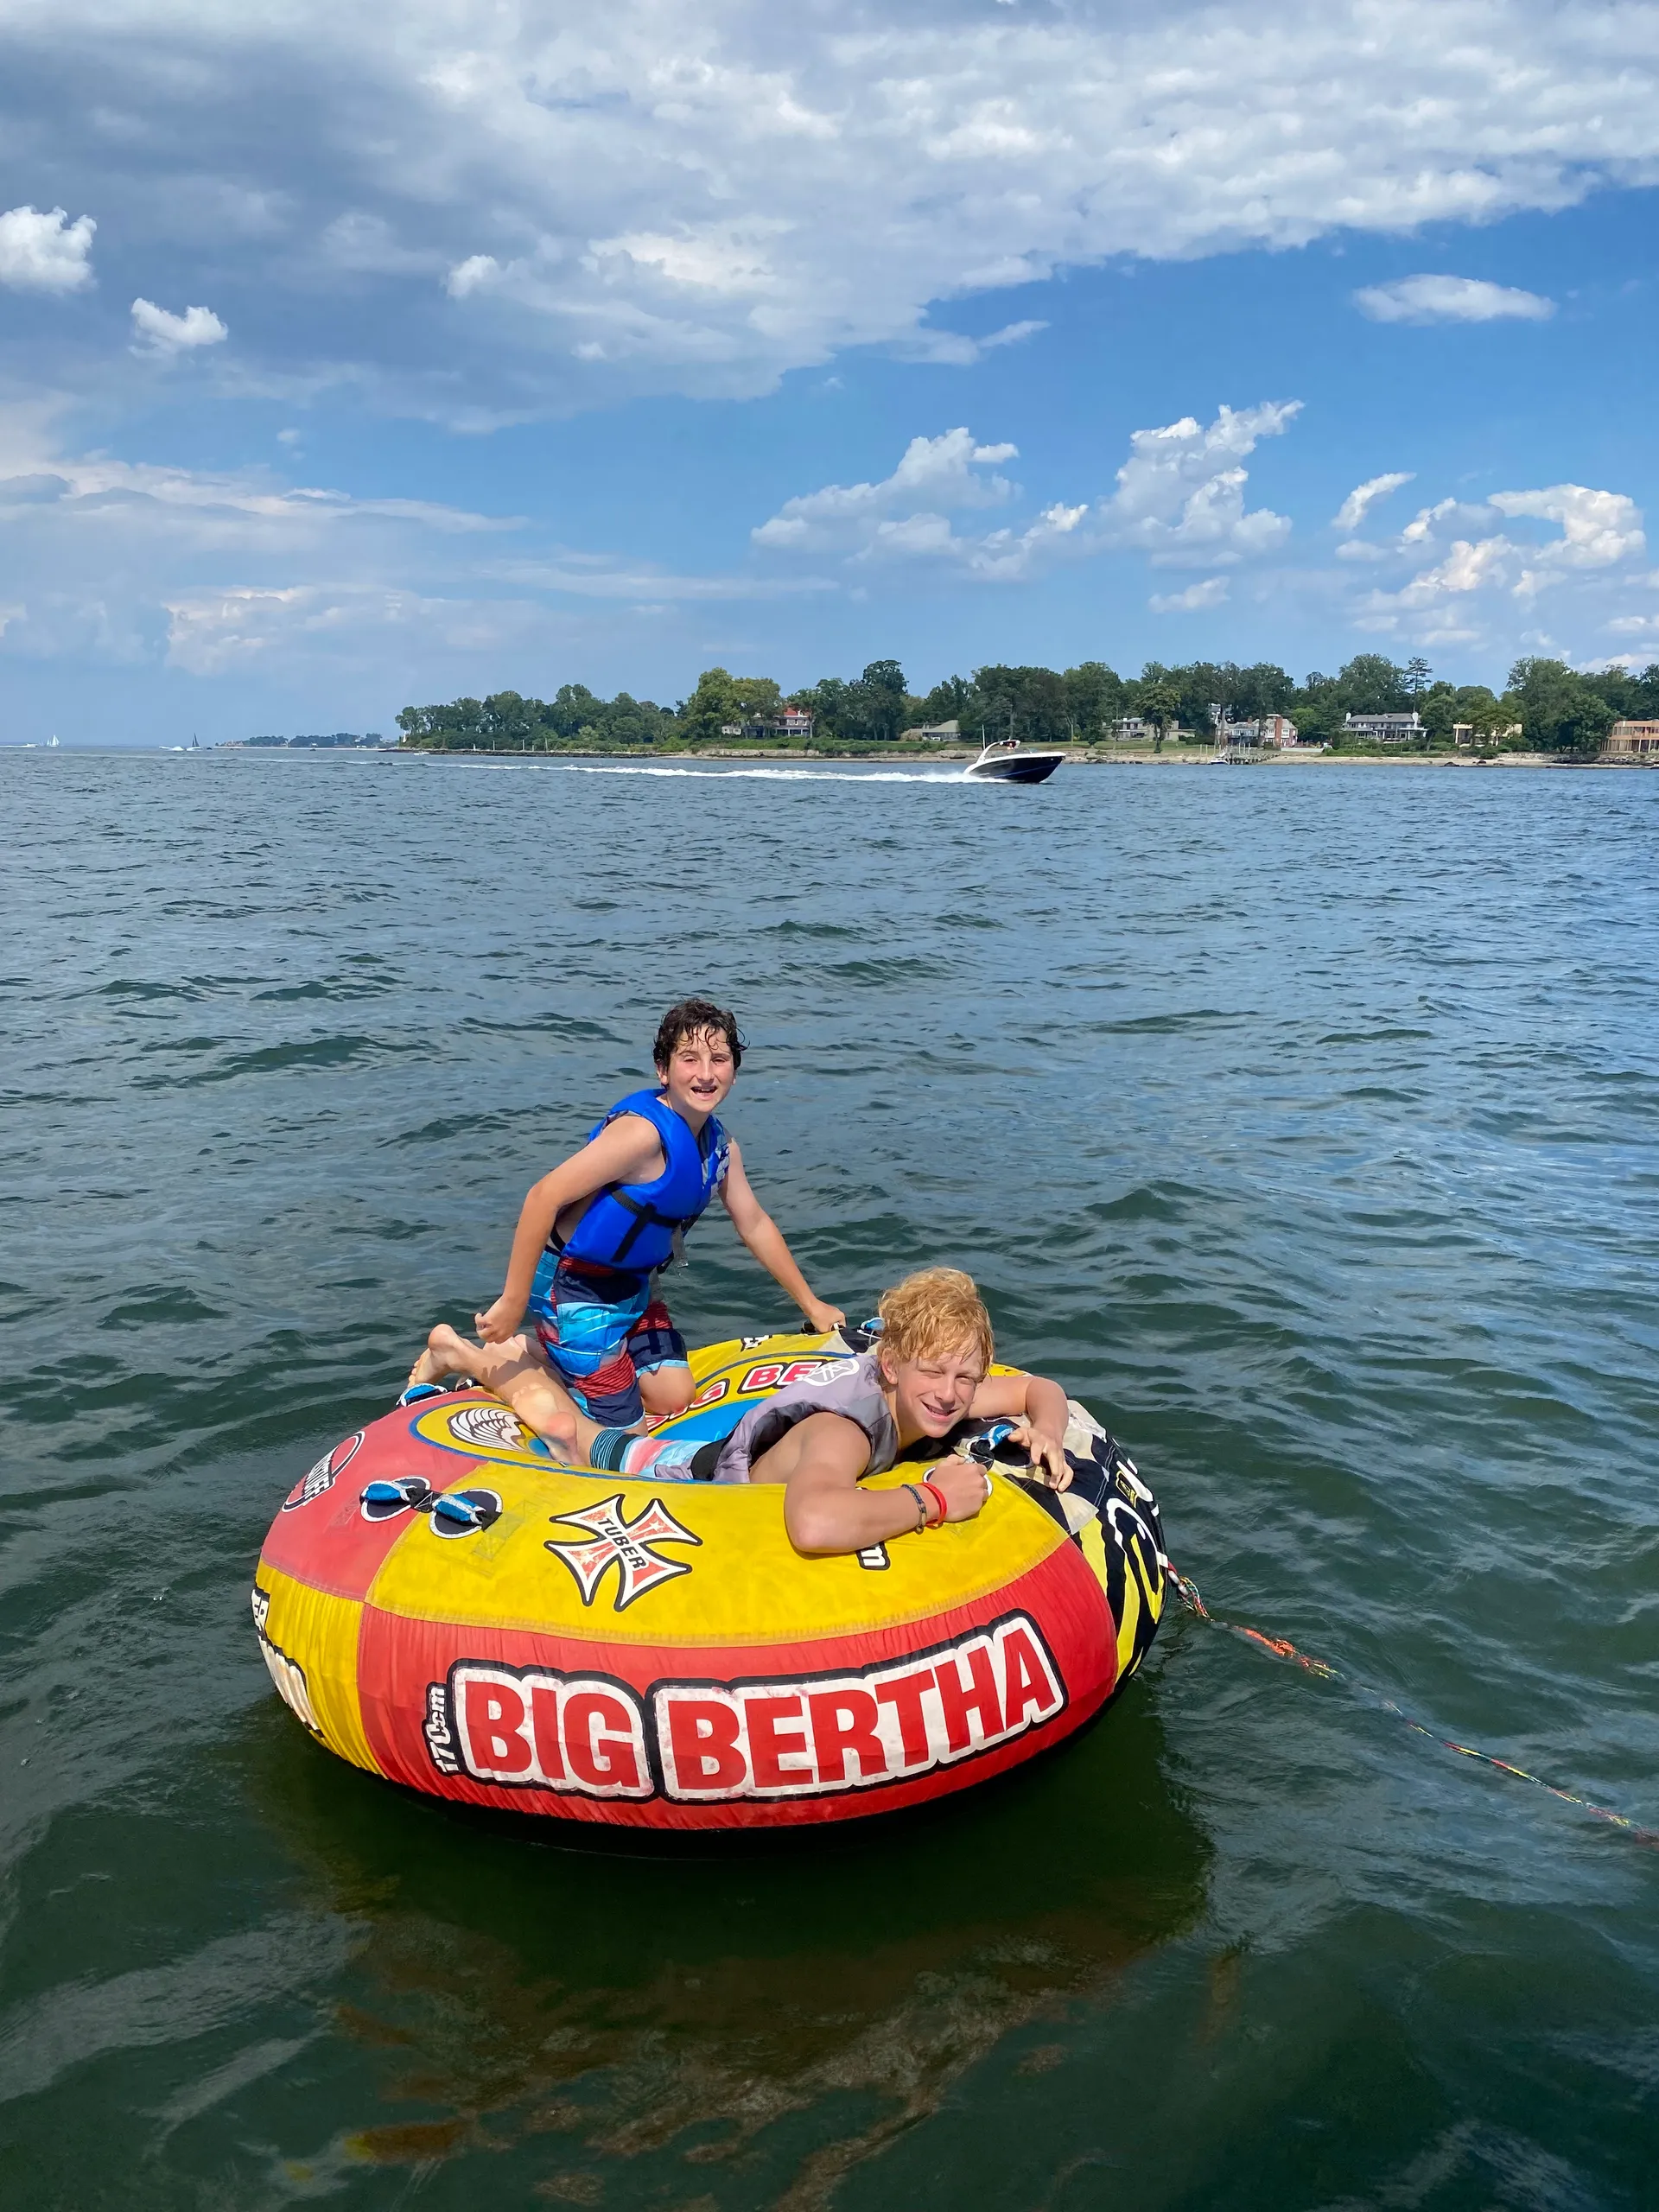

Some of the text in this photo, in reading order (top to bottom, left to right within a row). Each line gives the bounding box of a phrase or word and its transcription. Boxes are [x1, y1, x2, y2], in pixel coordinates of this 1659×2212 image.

[598, 1517, 646, 1569] TUBER
[465, 1628, 1057, 1790] BIG BERTHA
